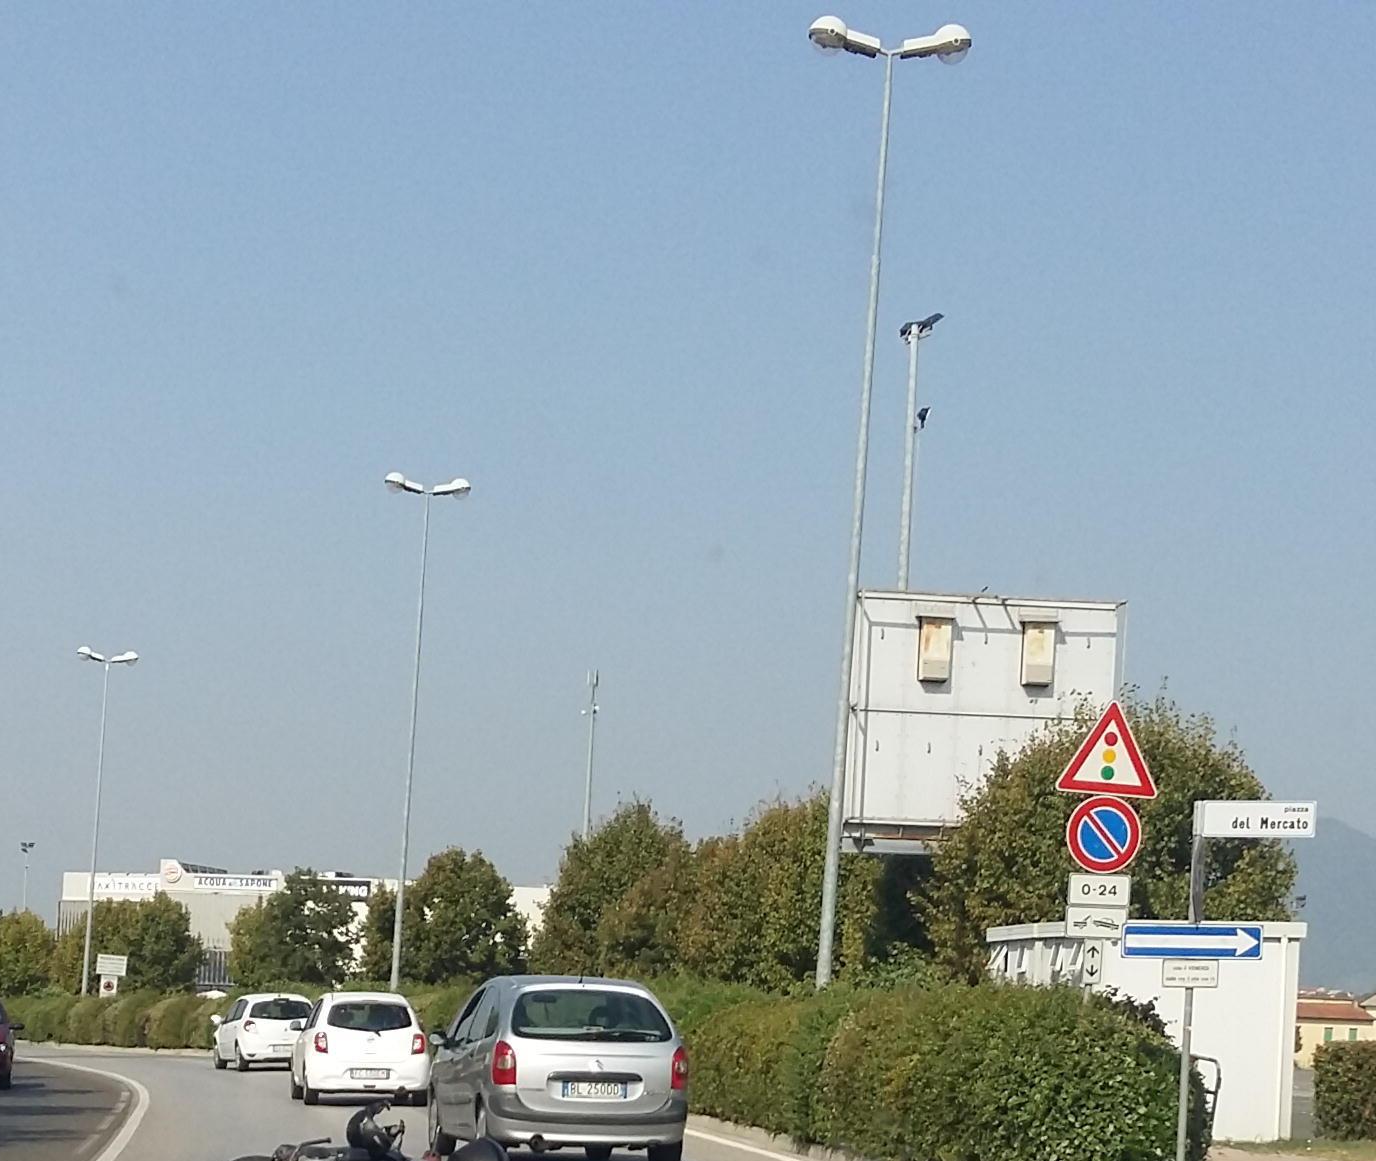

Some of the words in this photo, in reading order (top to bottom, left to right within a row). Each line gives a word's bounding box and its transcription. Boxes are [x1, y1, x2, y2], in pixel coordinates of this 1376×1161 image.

[1232, 817, 1251, 830] del
[1260, 817, 1309, 830] Mercato
[197, 877, 227, 887] ACQUA
[239, 879, 273, 888] SAPONE
[1081, 883, 1118, 897] 0-24
